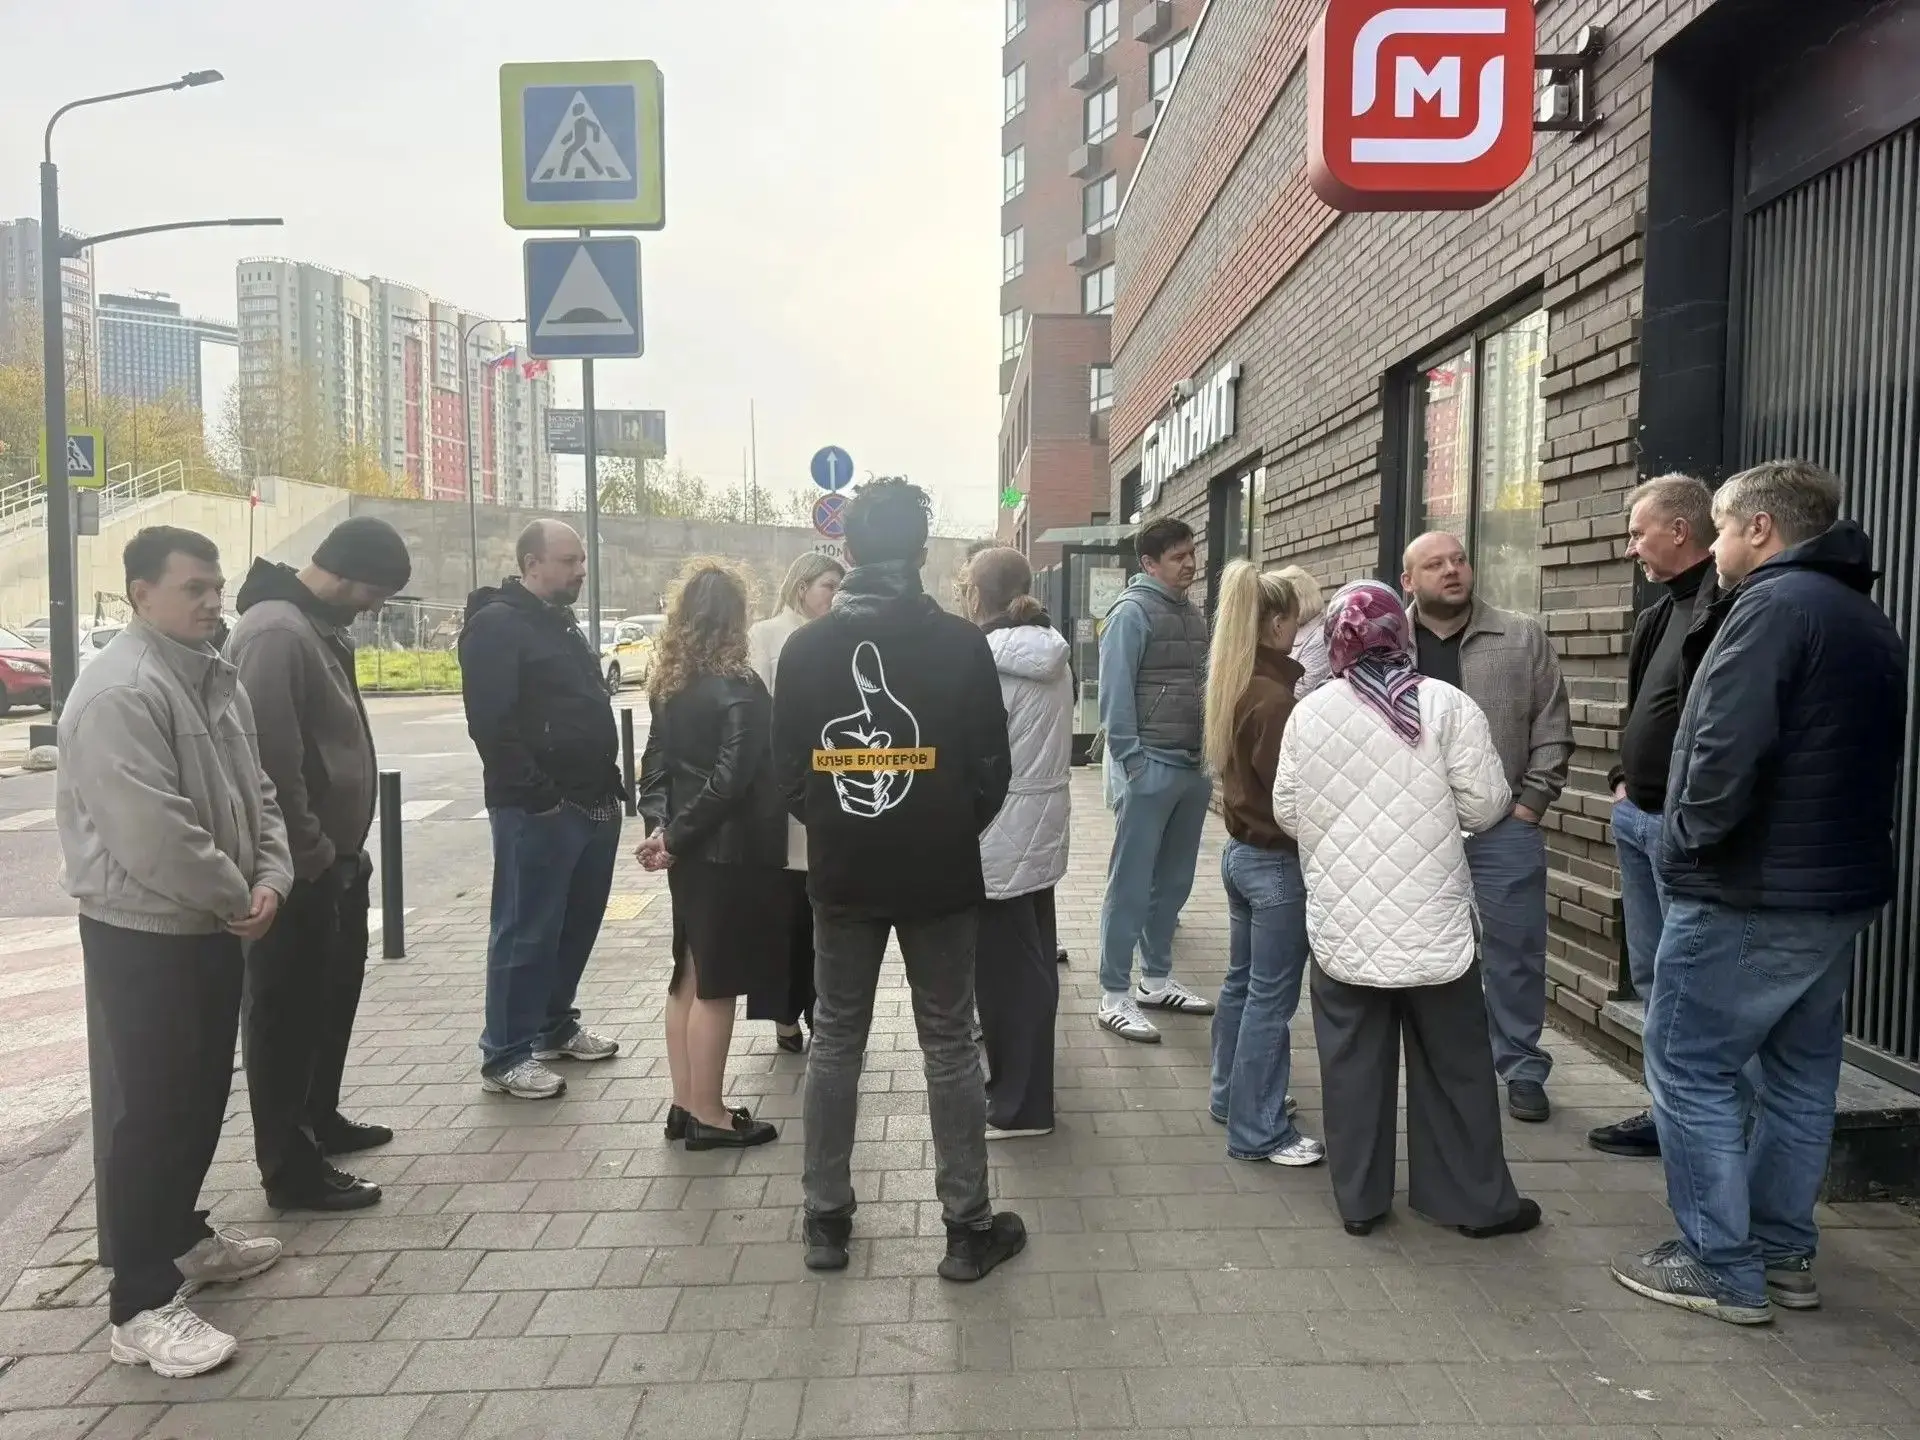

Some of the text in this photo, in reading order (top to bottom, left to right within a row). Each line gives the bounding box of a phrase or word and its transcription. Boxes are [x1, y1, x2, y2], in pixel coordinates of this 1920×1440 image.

[1158, 360, 1239, 484] МАГНИТ
[816, 752, 928, 767] КЛУБ БЛОГЕРОВ
